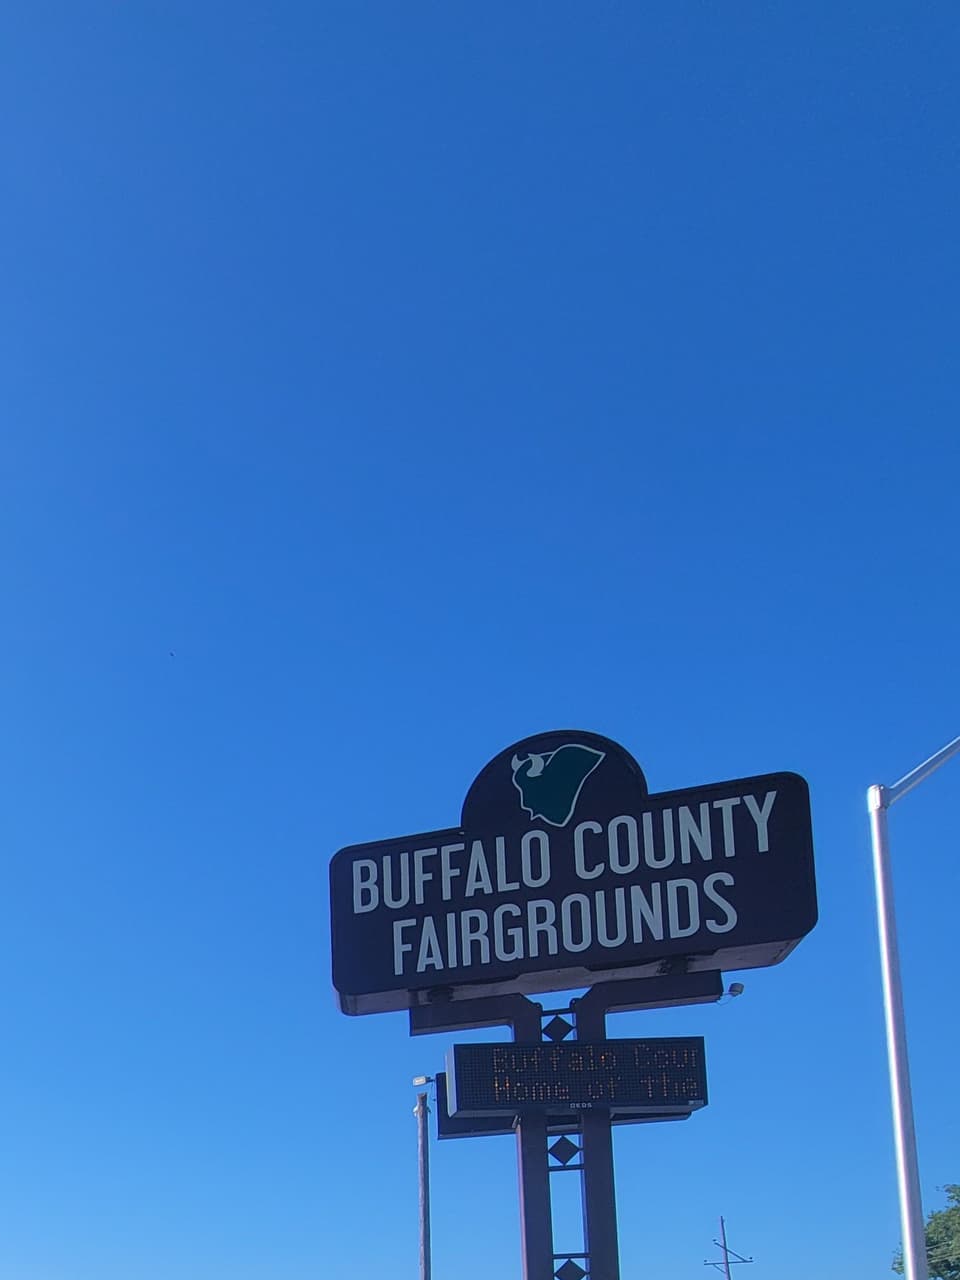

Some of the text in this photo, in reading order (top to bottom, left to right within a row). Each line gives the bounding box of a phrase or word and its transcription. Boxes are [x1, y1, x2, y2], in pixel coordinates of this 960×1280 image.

[352, 790, 778, 914] BUFFALO COUNTY
[393, 871, 739, 976] FAIRGROUNDS
[493, 1044, 617, 1073] Buffalo
[493, 1071, 699, 1102] Home of The
